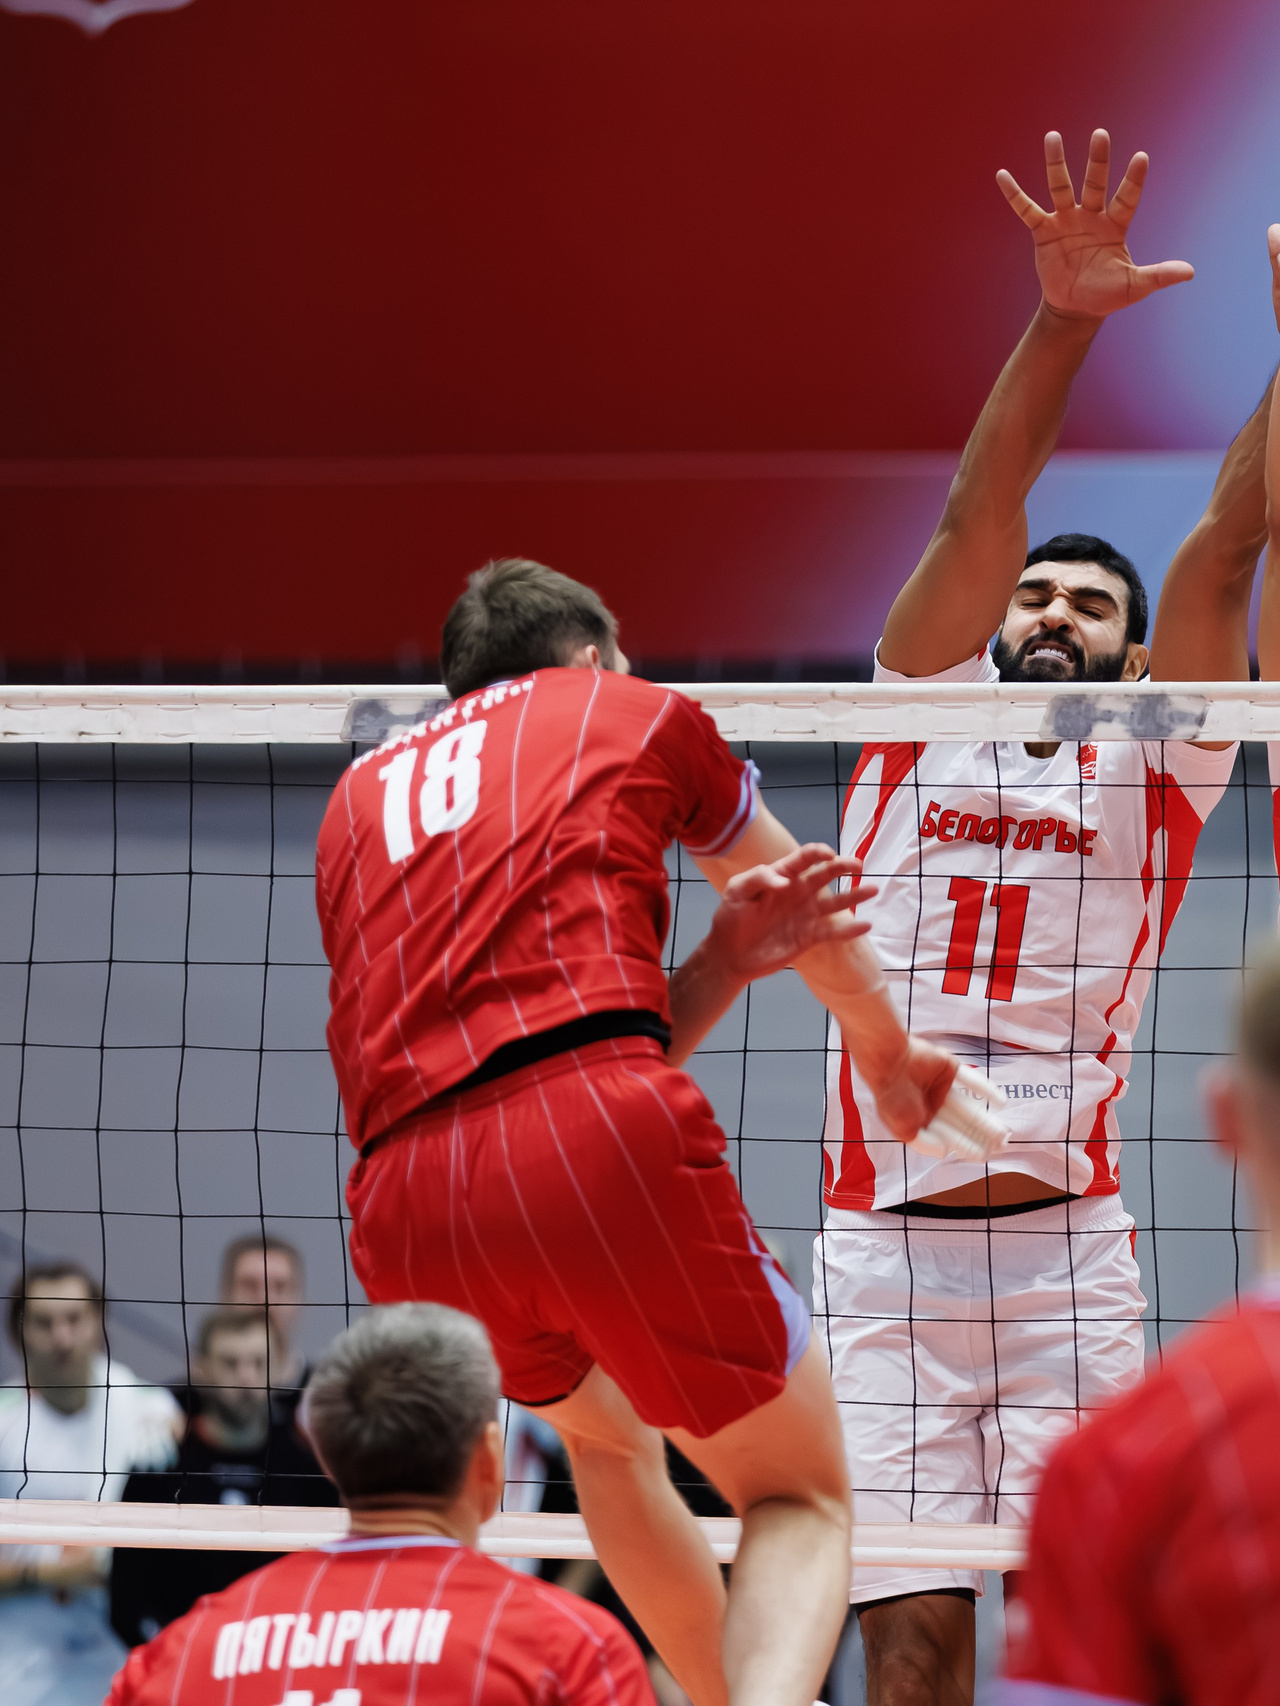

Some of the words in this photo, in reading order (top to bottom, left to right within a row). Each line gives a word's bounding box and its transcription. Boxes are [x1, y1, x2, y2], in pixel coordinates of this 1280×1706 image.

[378, 719, 488, 865] 18
[919, 800, 1098, 857] БЕЛОГОРЬЕ
[941, 876, 1030, 1002] 11
[212, 1608, 452, 1680] ПЯТЫРКИН
